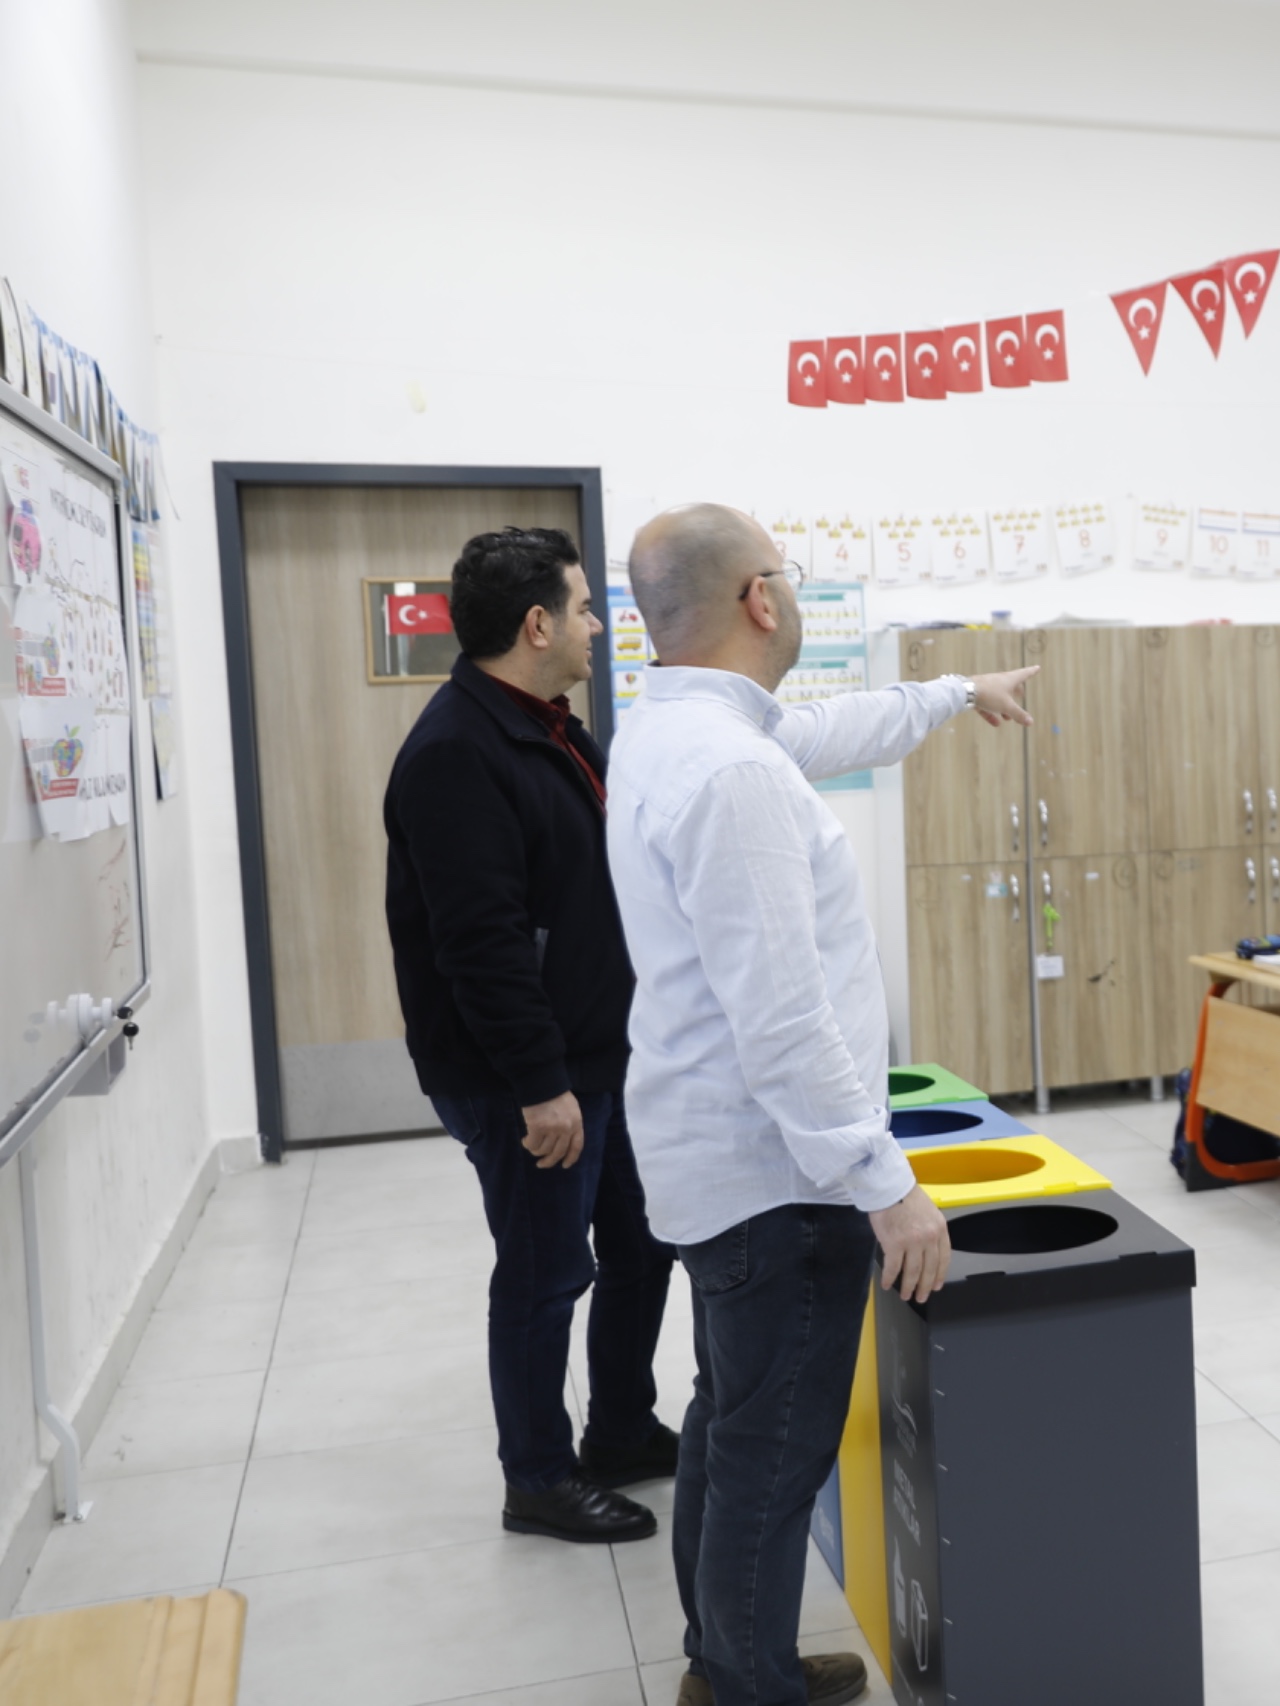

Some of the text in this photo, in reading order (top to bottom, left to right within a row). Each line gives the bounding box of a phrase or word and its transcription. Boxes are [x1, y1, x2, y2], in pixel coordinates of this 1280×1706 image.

[1013, 535, 1026, 555] 7
[1078, 529, 1091, 549] 8
[1156, 528, 1169, 547] 9
[1209, 534, 1229, 555] 10
[835, 543, 849, 562] 4
[897, 542, 912, 562] 5
[954, 541, 967, 559] 6
[1256, 539, 1271, 558] 11
